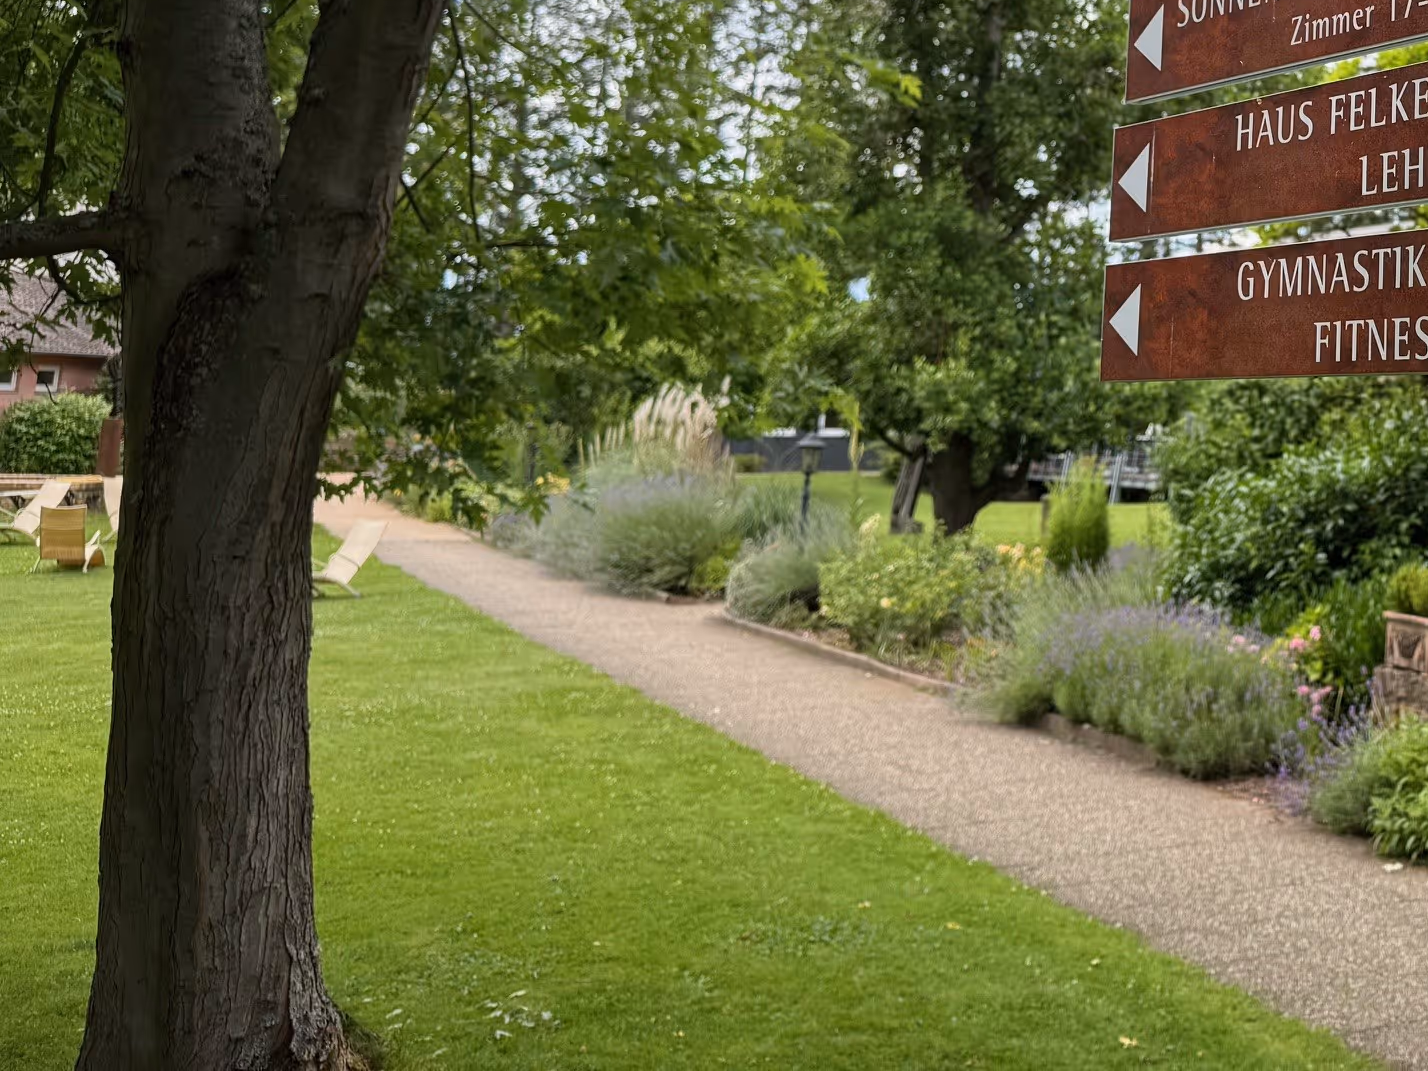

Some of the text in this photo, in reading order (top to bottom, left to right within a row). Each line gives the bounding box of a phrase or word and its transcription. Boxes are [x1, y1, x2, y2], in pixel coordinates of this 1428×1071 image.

[1290, 5, 1375, 46] Zimmer
[1235, 101, 1314, 152] HAUS
[1236, 244, 1427, 301] GYMNASTIK
